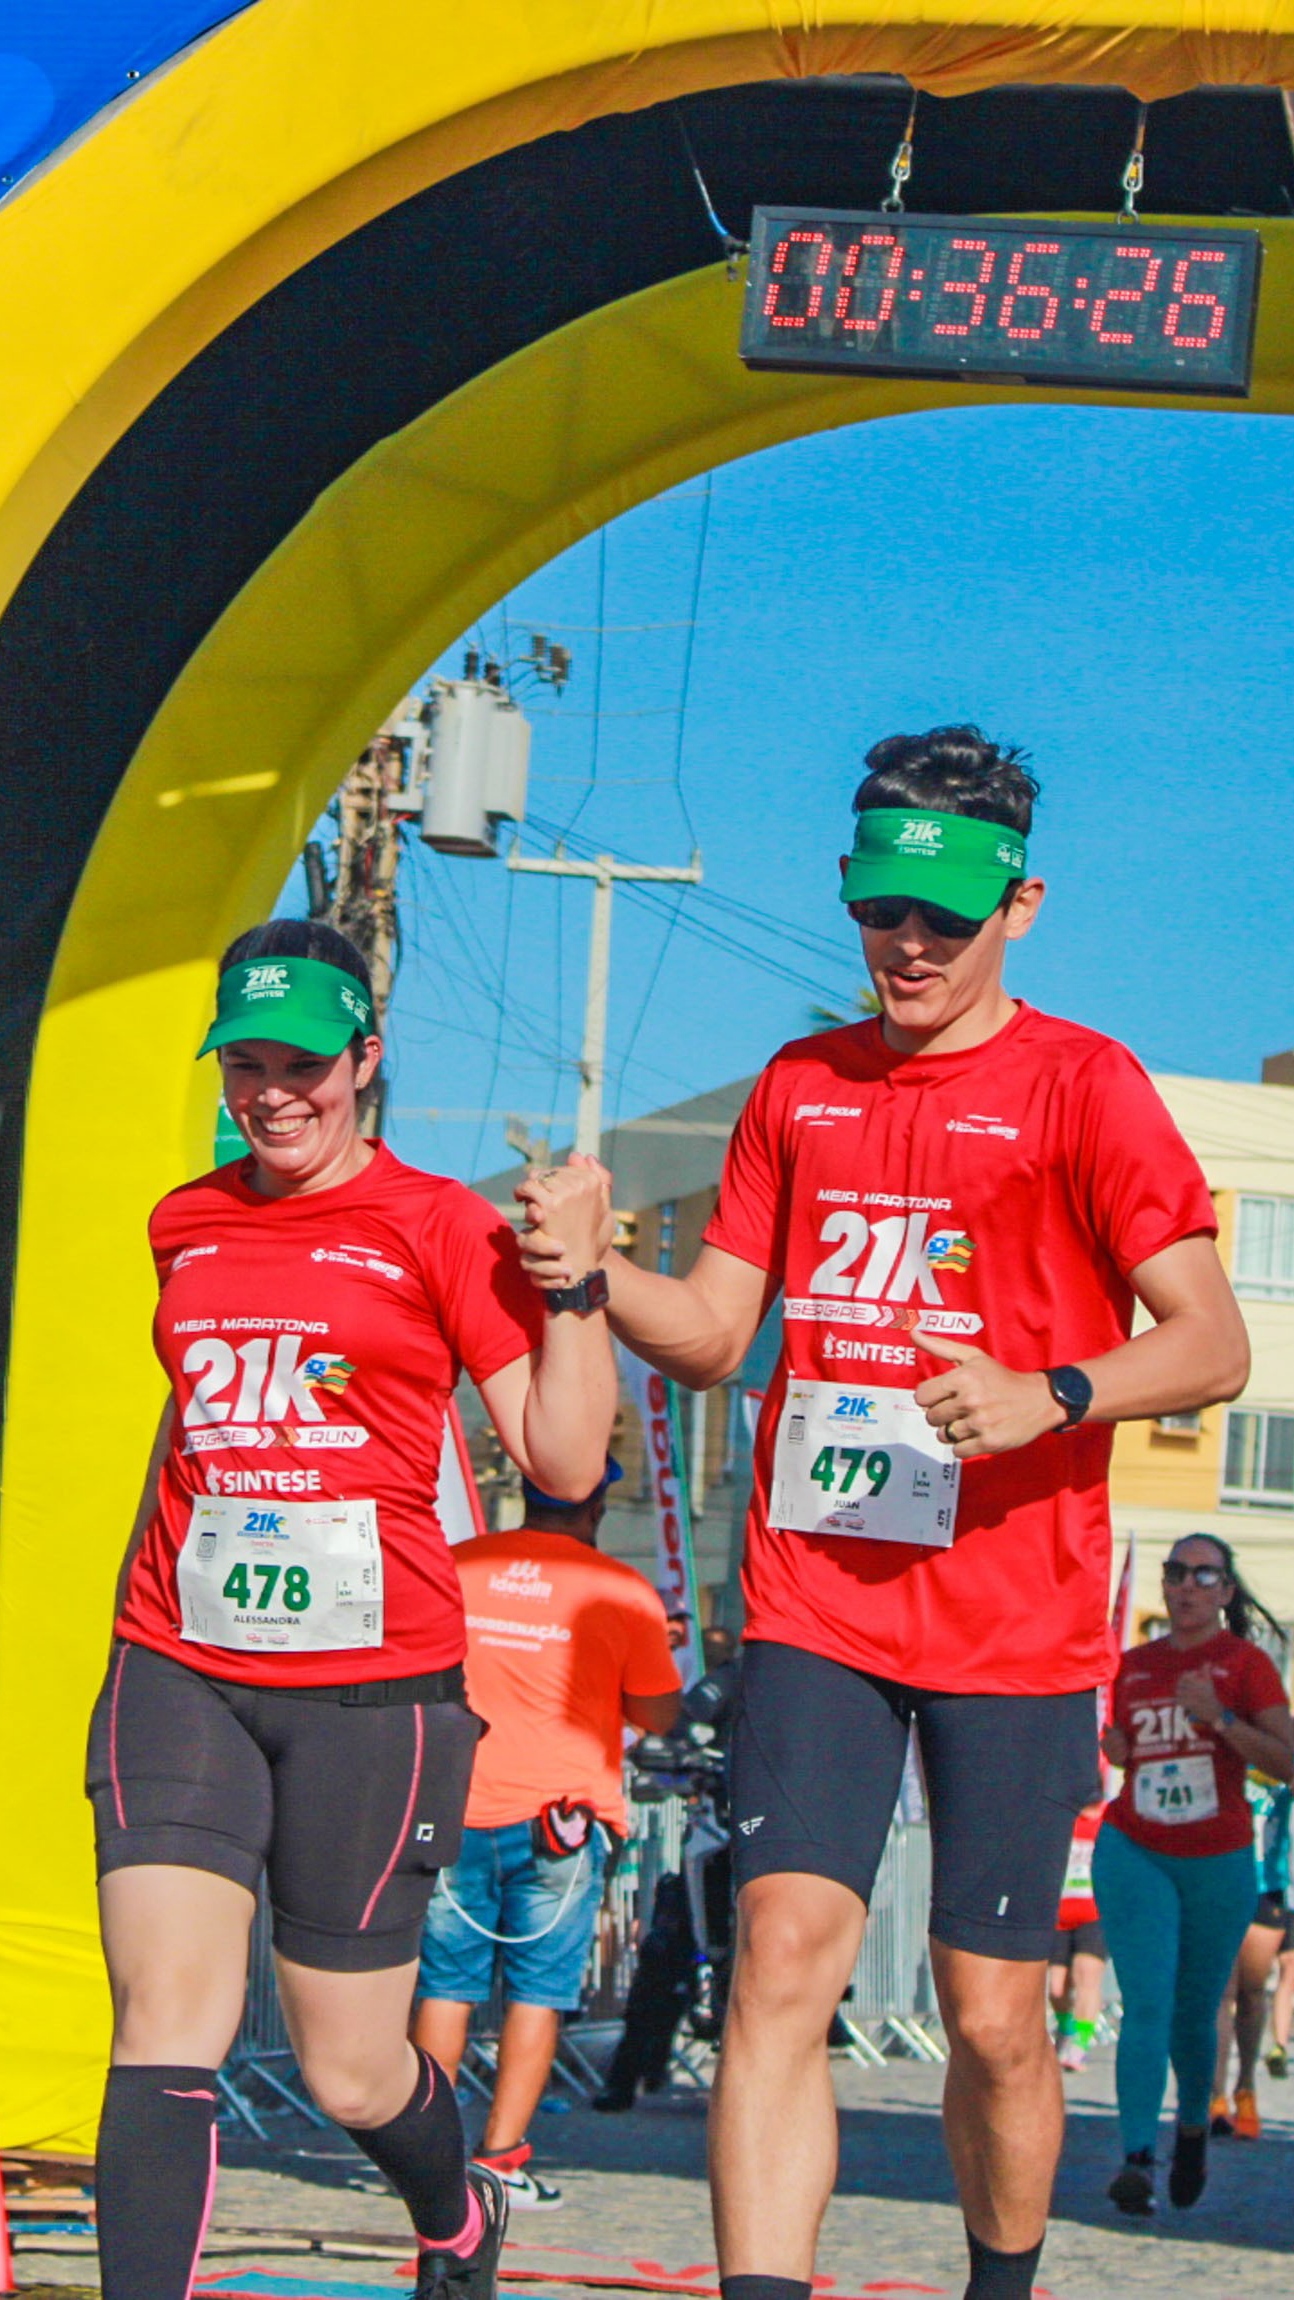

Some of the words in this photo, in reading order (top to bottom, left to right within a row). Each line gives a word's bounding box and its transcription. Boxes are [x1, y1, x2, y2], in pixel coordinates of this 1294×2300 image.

[763, 231, 1227, 348] 00:36:26
[817, 1189, 858, 1203] MEIA
[863, 1193, 952, 1211] MARATONA
[173, 1319, 217, 1334] MEIA
[221, 1318, 329, 1335] MARATONA
[790, 1302, 866, 1320] SERGIPE
[925, 1314, 972, 1329] RUN
[836, 1340, 916, 1365] SINTESE
[309, 1430, 356, 1444] RUN
[223, 1469, 322, 1494] SINTESE
[810, 1446, 892, 1497] 479
[833, 1499, 860, 1509] JUAN
[223, 1563, 311, 1612] 478
[233, 1614, 302, 1625] ALESSANDRA
[1156, 1785, 1193, 1809] 741
